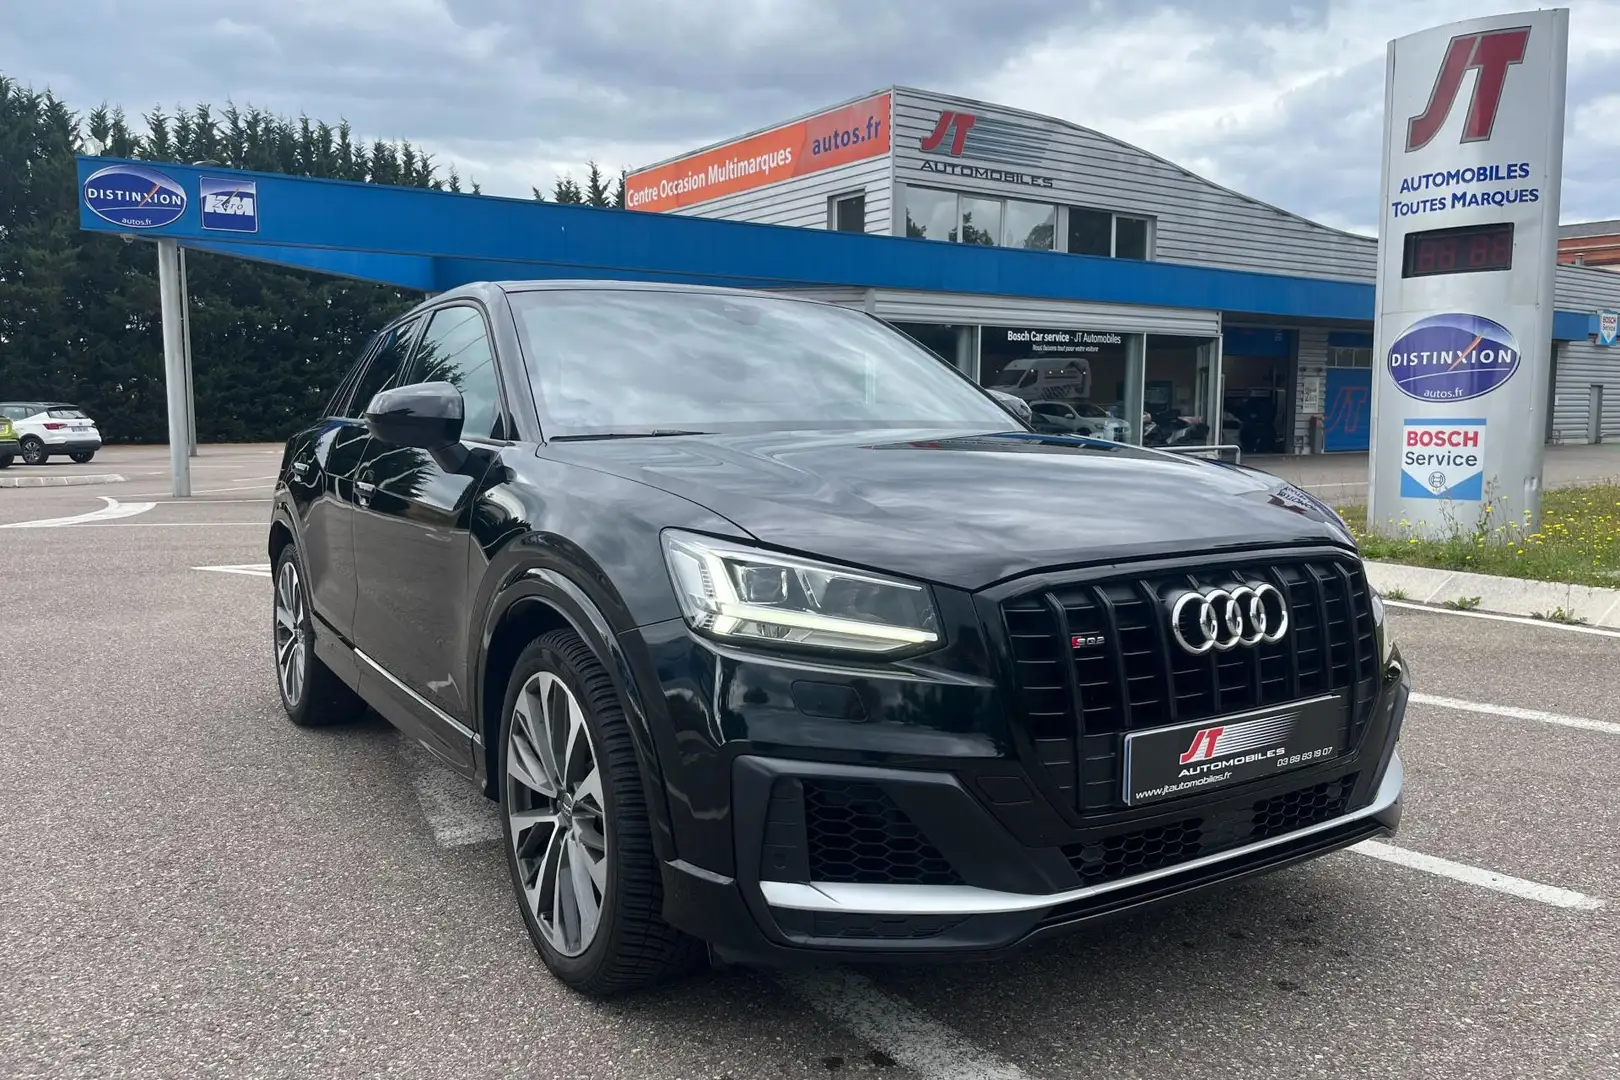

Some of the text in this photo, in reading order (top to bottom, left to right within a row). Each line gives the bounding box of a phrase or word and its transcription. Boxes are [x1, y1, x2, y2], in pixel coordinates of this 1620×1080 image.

[1405, 25, 1532, 153] JT
[920, 110, 976, 158] JT
[627, 116, 882, 207] Centre Occasion Multimarques autos.fr
[920, 160, 1053, 188] AUTOMOBILES
[1399, 163, 1530, 193] AUTOMOBILES
[88, 187, 181, 206] DISTINXION
[1392, 189, 1539, 217] TOUTES MARQUES
[121, 217, 152, 226] autos.fr
[1007, 330, 1030, 341] Bosch
[1031, 331, 1043, 341] Car
[1044, 331, 1070, 342] service
[1074, 332, 1082, 342] JT
[1083, 333, 1121, 344] Automobiles
[1392, 349, 1512, 367] DISTINXION
[1424, 387, 1464, 398] autos.fr
[1406, 430, 1479, 447] BOSCH
[1405, 451, 1478, 467] Service
[1072, 636, 1105, 648] SQ2
[1179, 726, 1224, 765] JT
[1276, 757, 1288, 767] 03
[1313, 749, 1322, 758] 19
[1322, 746, 1333, 756] 07
[1178, 747, 1286, 777] AUTOMOBILES
[1135, 771, 1232, 799] www.jtautomobiles.fr
